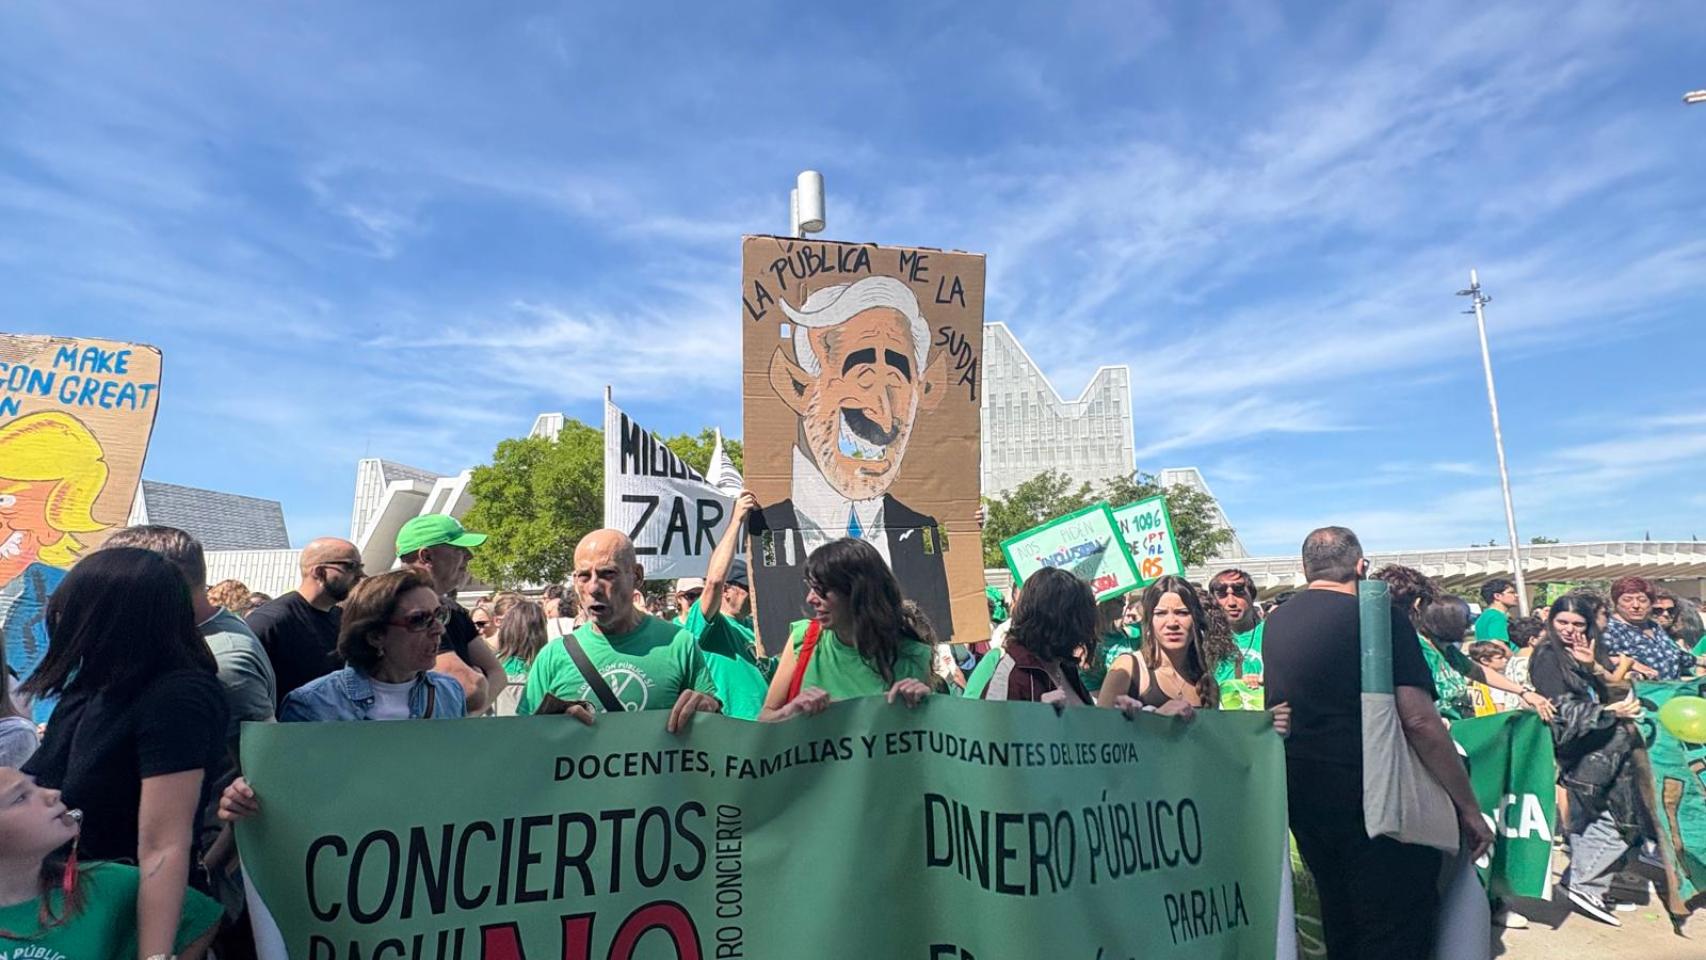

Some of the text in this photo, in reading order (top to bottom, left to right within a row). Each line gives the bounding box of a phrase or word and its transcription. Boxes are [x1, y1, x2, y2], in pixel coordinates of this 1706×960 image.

[743, 242, 977, 401] LA PÚBLICA ME LA SUDA
[53, 345, 131, 374] MAKE
[59, 376, 157, 410] GREAT
[622, 494, 748, 556] ZAR
[554, 730, 1139, 781] DOCENTES, FAMILIAS Y ESTUDIANTES DEL IES GOYA
[305, 802, 707, 925] CONCIERTOS
[716, 805, 742, 918] CONCIERTO
[924, 790, 1202, 896] DINERO PÚBLICO
[1163, 881, 1249, 945] PARA LA
